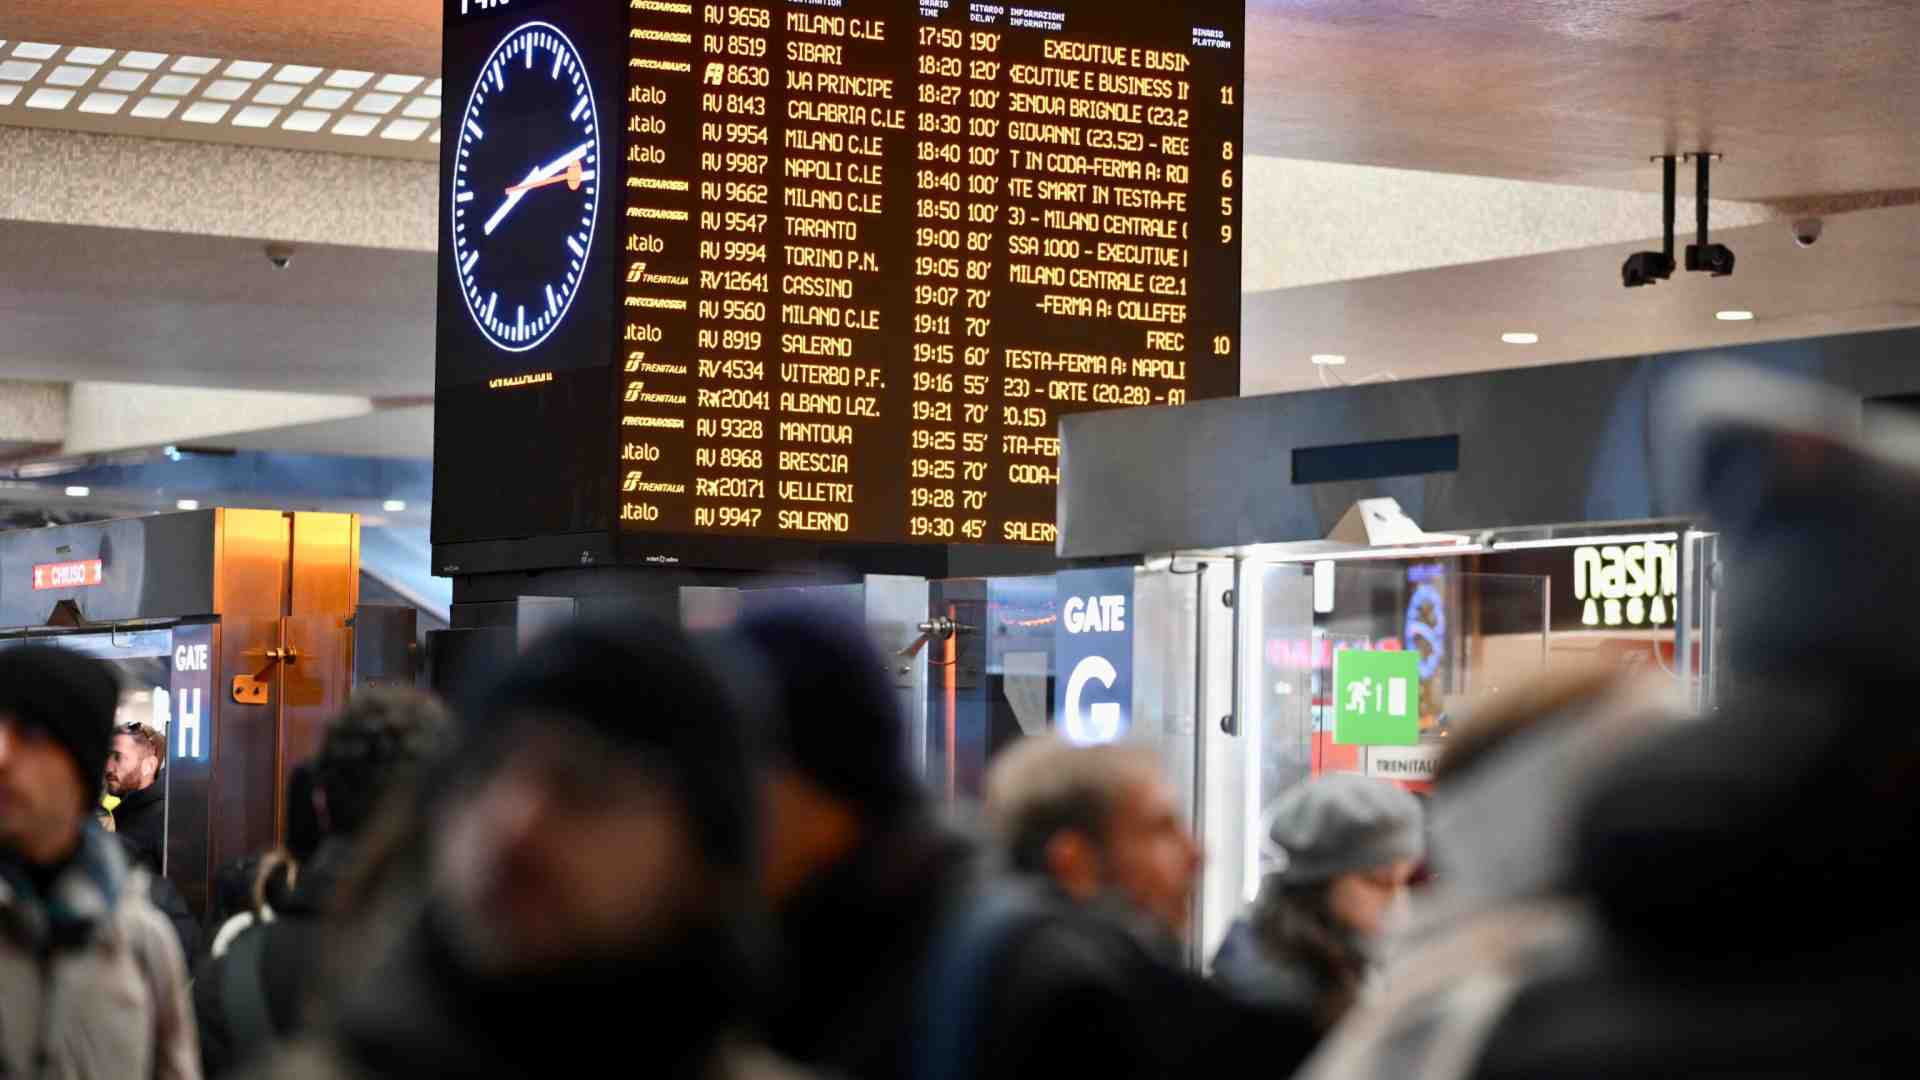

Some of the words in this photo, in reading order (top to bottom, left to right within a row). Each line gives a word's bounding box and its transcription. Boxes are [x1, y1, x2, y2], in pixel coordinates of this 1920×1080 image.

[920, 7, 938, 17] TIME
[970, 3, 1004, 15] RITARDO
[970, 13, 996, 23] DELAY
[1010, 8, 1065, 21] INFORMAZIONI
[1010, 17, 1061, 30] INFORMATION
[705, 5, 723, 24] AV
[728, 6, 770, 28] 9658
[787, 12, 844, 36] MILANO
[850, 19, 884, 40] C.LE
[919, 27, 962, 48] 17:50
[1044, 39, 1127, 66] EXECUTIVE
[1192, 37, 1231, 48] PLATFORM
[704, 35, 723, 54] AV
[728, 35, 766, 57] 8519
[787, 41, 842, 65] SIBARI
[919, 55, 962, 77] 18:20
[1099, 73, 1172, 98] BUSINESS
[1221, 86, 1233, 104] 11
[727, 65, 769, 86] 8630
[818, 73, 893, 99] PRINCIPE
[918, 84, 961, 105] 18:27
[1070, 98, 1142, 123] BRIGNOLE
[703, 93, 722, 112] AV
[727, 94, 765, 115] 8143
[788, 100, 866, 125] CALABRIA
[871, 108, 905, 129] C.LE
[918, 113, 960, 134] 18:30
[1009, 121, 1080, 145] GIOVANNI
[1087, 129, 1143, 151] (23.52)
[1223, 142, 1233, 160] 8
[702, 123, 722, 142] AV
[727, 123, 768, 145] 9954
[785, 129, 843, 152] MILANO
[848, 135, 882, 156] C.LE
[918, 142, 960, 163] 18:40
[1025, 151, 1042, 170] IN
[1047, 153, 1141, 179] CODA-FERMA
[1145, 162, 1161, 181] A:
[1222, 170, 1232, 187] 6
[702, 152, 721, 171] AV
[726, 152, 768, 174] 9987
[785, 158, 842, 181] NAPOLI
[848, 163, 882, 184] C.LE
[917, 170, 960, 191] 18:40
[1038, 180, 1087, 202] SMART
[1092, 185, 1109, 205] IN
[1222, 197, 1232, 215] 5
[702, 182, 721, 201] AV
[726, 182, 768, 204] 9662
[785, 187, 842, 210] MILANO
[847, 193, 882, 213] C.LE
[917, 199, 960, 220] 18:50
[1044, 209, 1099, 232] MILANO
[1103, 215, 1178, 239] CENTRALE
[1221, 225, 1231, 243] 9
[701, 211, 720, 231] AV
[725, 212, 767, 232] 9547
[785, 216, 856, 240] TARANTO
[916, 228, 960, 248] 19:00
[1044, 238, 1079, 258] 1000
[1097, 242, 1179, 267] EXECUTIVE
[700, 241, 721, 259] AV
[723, 242, 767, 263] 9994
[784, 246, 843, 269] TORINO
[848, 251, 878, 272] P.N.
[915, 257, 959, 278] 19:05
[1010, 264, 1065, 287] MILANO
[1069, 270, 1145, 292] CENTRALE
[642, 273, 689, 285] TRENITALIA
[783, 275, 852, 298] CASSINO
[915, 285, 958, 306] 19:07
[1096, 299, 1113, 318] A:
[699, 301, 717, 319] AV
[723, 301, 766, 321] 9560
[782, 304, 840, 327] MILANO
[845, 309, 880, 330] C.LE
[914, 314, 950, 335] 19:11
[1147, 331, 1184, 351] FREC
[1214, 336, 1230, 354] 10
[699, 329, 718, 349] AV
[723, 330, 761, 350] 8919
[782, 334, 852, 357] SALERNO
[914, 343, 953, 364] 19:15
[1005, 349, 1107, 374] TESTA-FERMA
[1111, 357, 1127, 375] A:
[1132, 358, 1185, 379] NAPOLI
[640, 362, 688, 375] TRENITALIA
[781, 363, 850, 386] VITERBO
[854, 368, 886, 388] P.F.
[913, 372, 952, 392] 19:16
[1049, 380, 1088, 401] ORTE
[1093, 384, 1150, 405] (20.28)
[640, 392, 687, 405] TRENITALIA
[780, 392, 841, 414] ALBANO
[846, 396, 880, 416] LAZ.
[913, 401, 952, 421] 19:21
[697, 418, 716, 437] AV
[721, 418, 763, 439] 9328
[780, 422, 852, 444] MANTOVA
[912, 430, 955, 450] 19:25
[696, 449, 715, 467] AV
[719, 448, 762, 468] 8968
[779, 451, 848, 473] BRESCIA
[912, 459, 955, 479] 19:25
[638, 481, 685, 494] TRENITALIA
[779, 480, 853, 503] VELLETRI
[911, 488, 954, 508] 19:28
[695, 507, 715, 527] AV
[719, 508, 762, 527] 9947
[778, 510, 848, 532] SALERNO
[910, 517, 954, 536] 19:30
[1064, 594, 1126, 634] GATE
[175, 644, 208, 671] GATE
[1065, 655, 1121, 744] G
[178, 688, 201, 758] H
